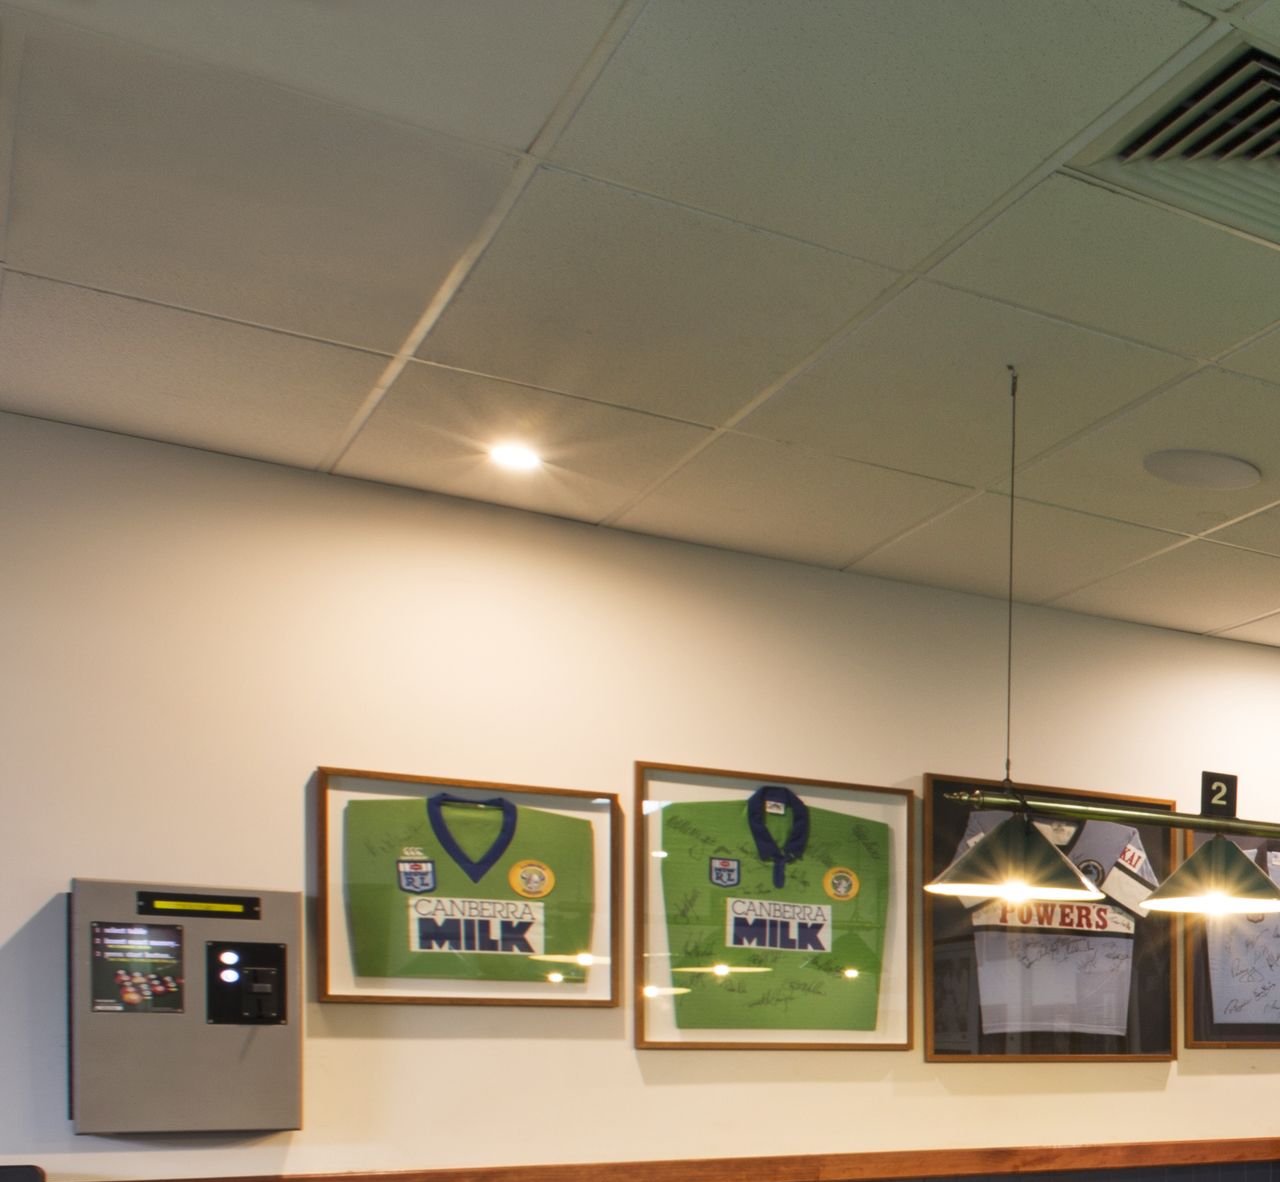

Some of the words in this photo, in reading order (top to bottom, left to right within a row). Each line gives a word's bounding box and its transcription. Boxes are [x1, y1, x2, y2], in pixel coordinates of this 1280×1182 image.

[1211, 781, 1228, 805] 2
[414, 898, 536, 921] CANBERRA
[731, 899, 828, 922] CANBERRA
[1000, 900, 1109, 930] POWER'S
[418, 917, 536, 953] MILK
[732, 916, 827, 951] MILK
